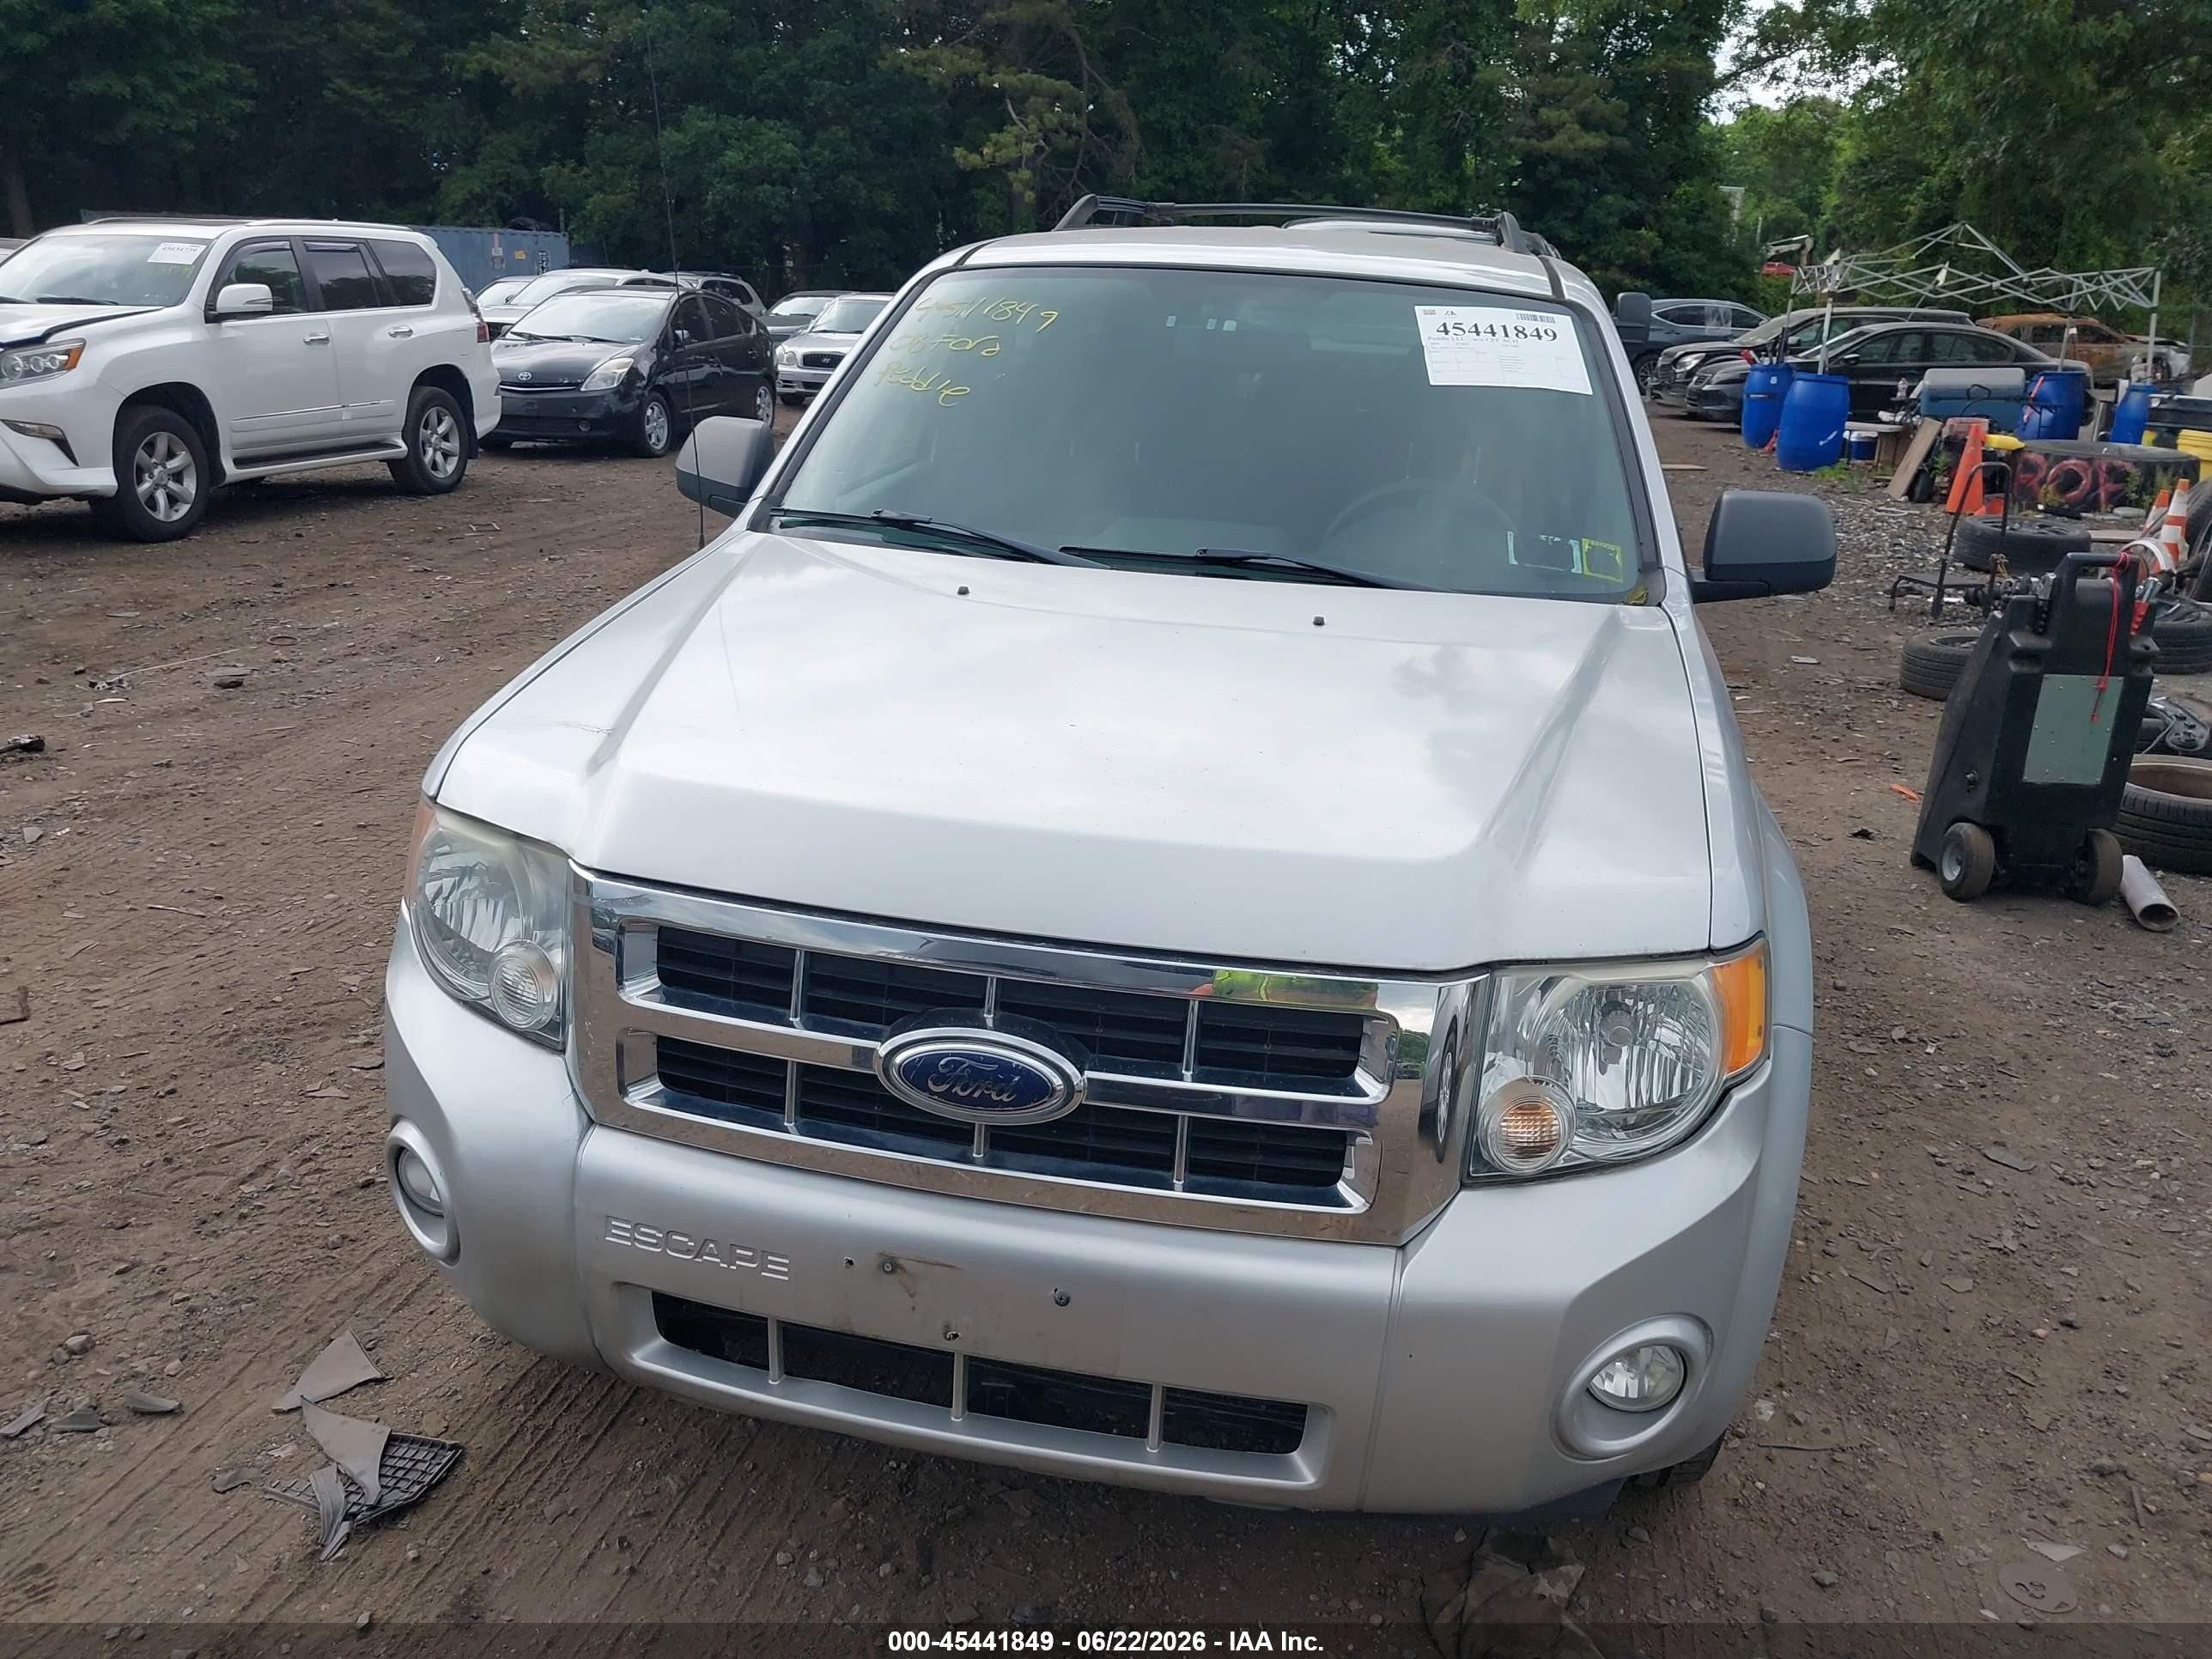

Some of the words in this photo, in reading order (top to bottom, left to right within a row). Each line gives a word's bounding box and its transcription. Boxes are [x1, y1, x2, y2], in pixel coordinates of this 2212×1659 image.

[1436, 321, 1558, 342] 45441849
[927, 1056, 1020, 1103] Ford
[605, 1215, 789, 1281] ESCAPE
